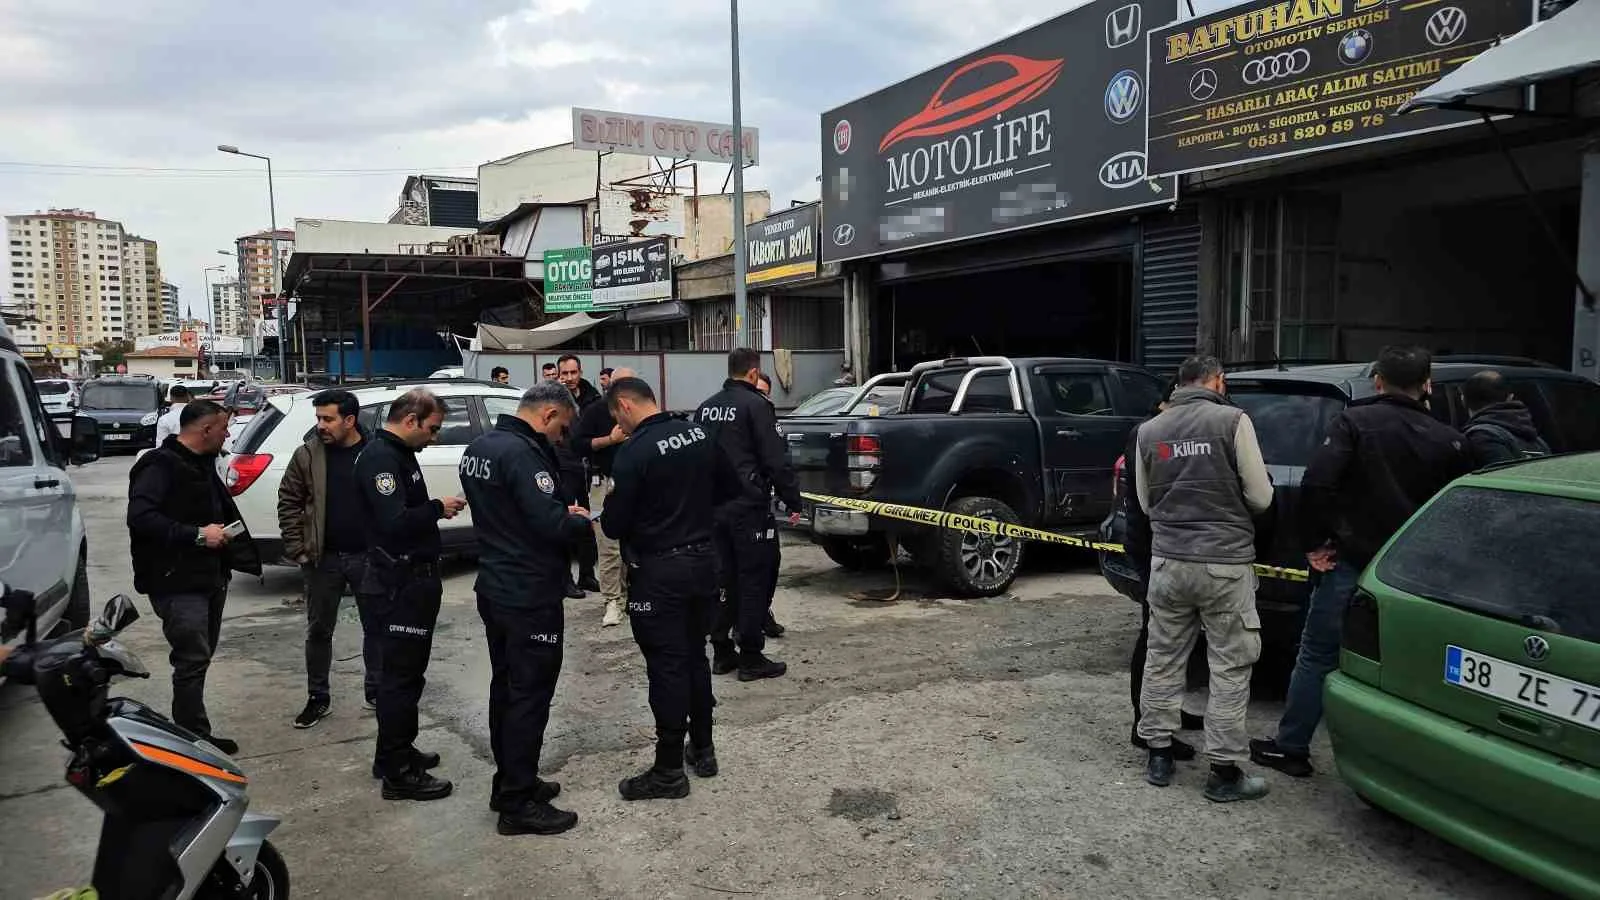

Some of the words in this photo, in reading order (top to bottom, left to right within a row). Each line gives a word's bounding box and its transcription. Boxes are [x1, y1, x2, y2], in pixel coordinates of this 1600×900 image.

[1166, 0, 1342, 64] BATUHAN
[1244, 26, 1322, 56] OTOMOTİV
[1326, 9, 1391, 34] SERVİSİ
[1206, 94, 1271, 121] HASARLI
[1274, 83, 1319, 106] ARAÇ
[1322, 72, 1368, 96] ALIM
[1372, 58, 1441, 85] SATIMI
[652, 122, 699, 153] OTO
[1232, 121, 1260, 137] BOYA
[1329, 99, 1372, 117] KASKO
[1248, 131, 1288, 149] 0531
[1293, 123, 1327, 141] 820
[1331, 118, 1354, 134] 89
[1360, 113, 1385, 129] 78
[885, 109, 1052, 194] MOTOLİFE
[1107, 158, 1142, 182] KIA
[612, 247, 645, 271] IŞIK
[749, 239, 786, 268] KABORTA
[789, 224, 813, 258] BOYA
[1173, 440, 1212, 458] kilim
[1463, 657, 1492, 688] 38
[1517, 672, 1550, 707] ZE
